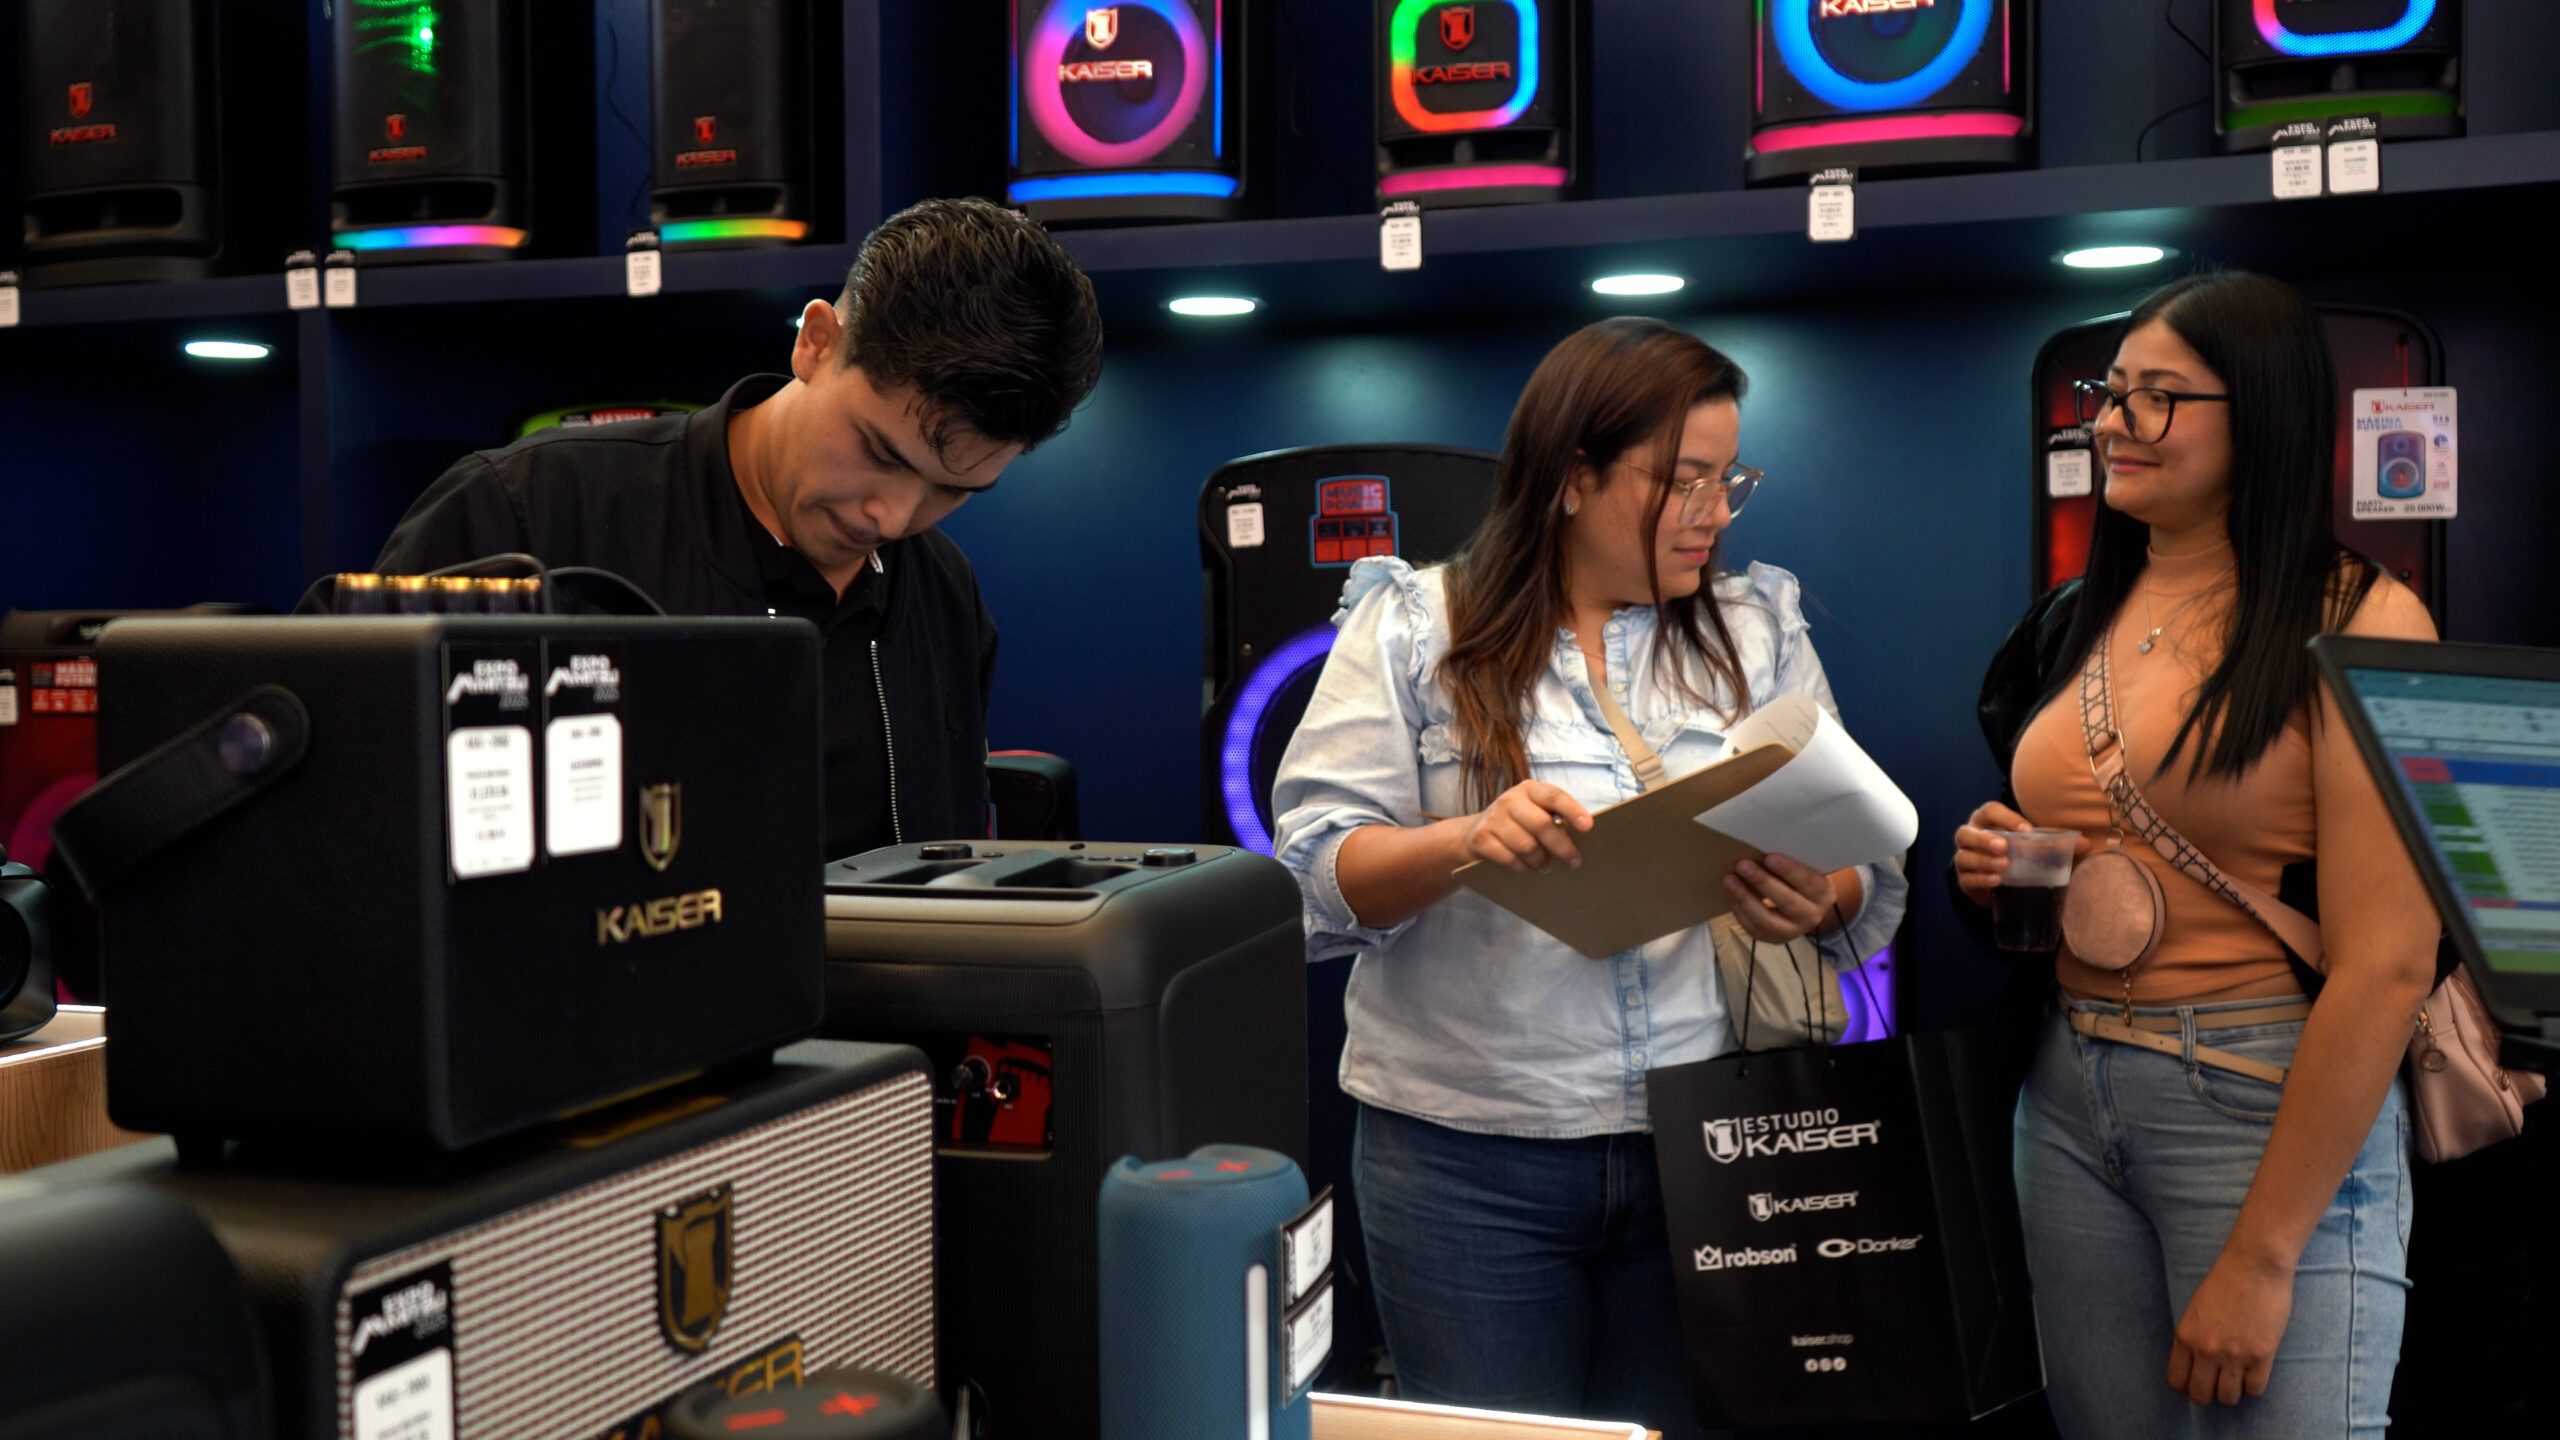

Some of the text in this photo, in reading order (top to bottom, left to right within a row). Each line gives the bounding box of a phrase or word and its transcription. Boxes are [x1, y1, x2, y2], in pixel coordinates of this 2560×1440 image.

[1058, 60, 1153, 81] KAISER
[1411, 61, 1511, 85] KAISER
[1323, 483, 1383, 499] MUSIC
[1323, 498, 1383, 511] POWER
[473, 659, 519, 676] EXPO
[570, 654, 611, 671] EXPO
[597, 887, 723, 946] KAISER
[1743, 1108, 1839, 1134] ESTUDIO
[1745, 1122, 1879, 1157] KAISER
[1774, 1192, 1857, 1214] KAISER
[1857, 1237, 1918, 1254] Donker
[1725, 1246, 1798, 1268] robson
